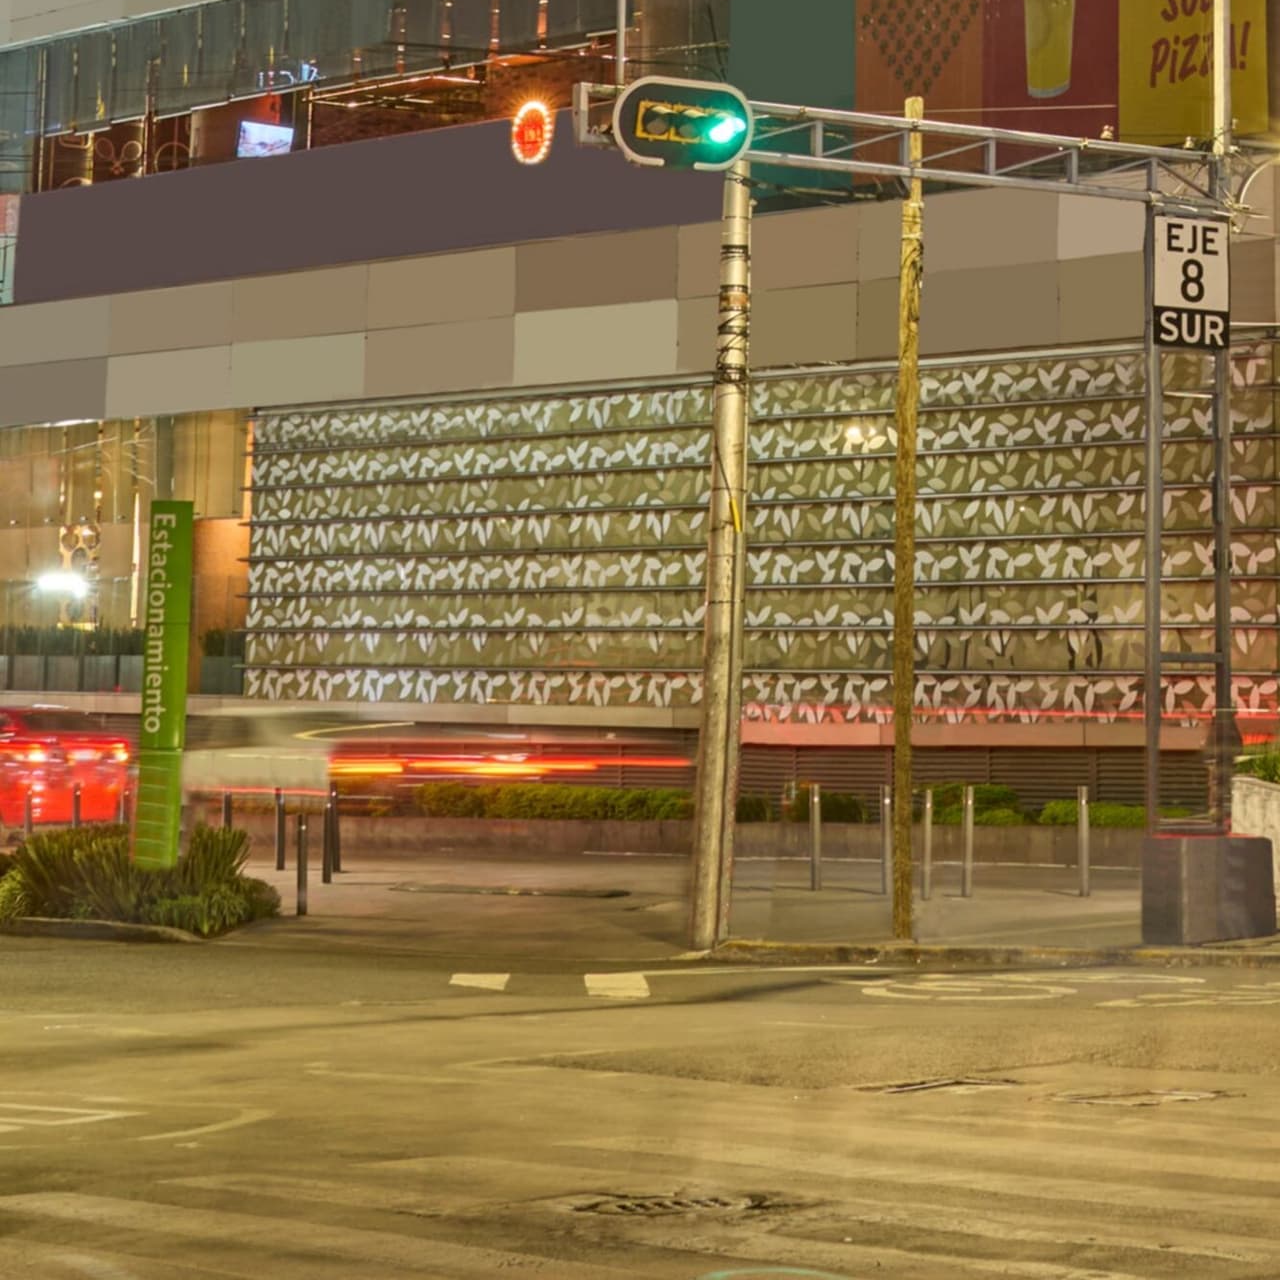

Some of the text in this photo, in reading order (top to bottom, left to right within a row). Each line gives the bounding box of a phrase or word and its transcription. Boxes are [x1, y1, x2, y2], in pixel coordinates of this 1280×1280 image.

[1166, 221, 1220, 256] EJE
[1180, 258, 1205, 303] 8
[1159, 310, 1225, 347] SUR
[144, 513, 176, 733] Estacionamiento
